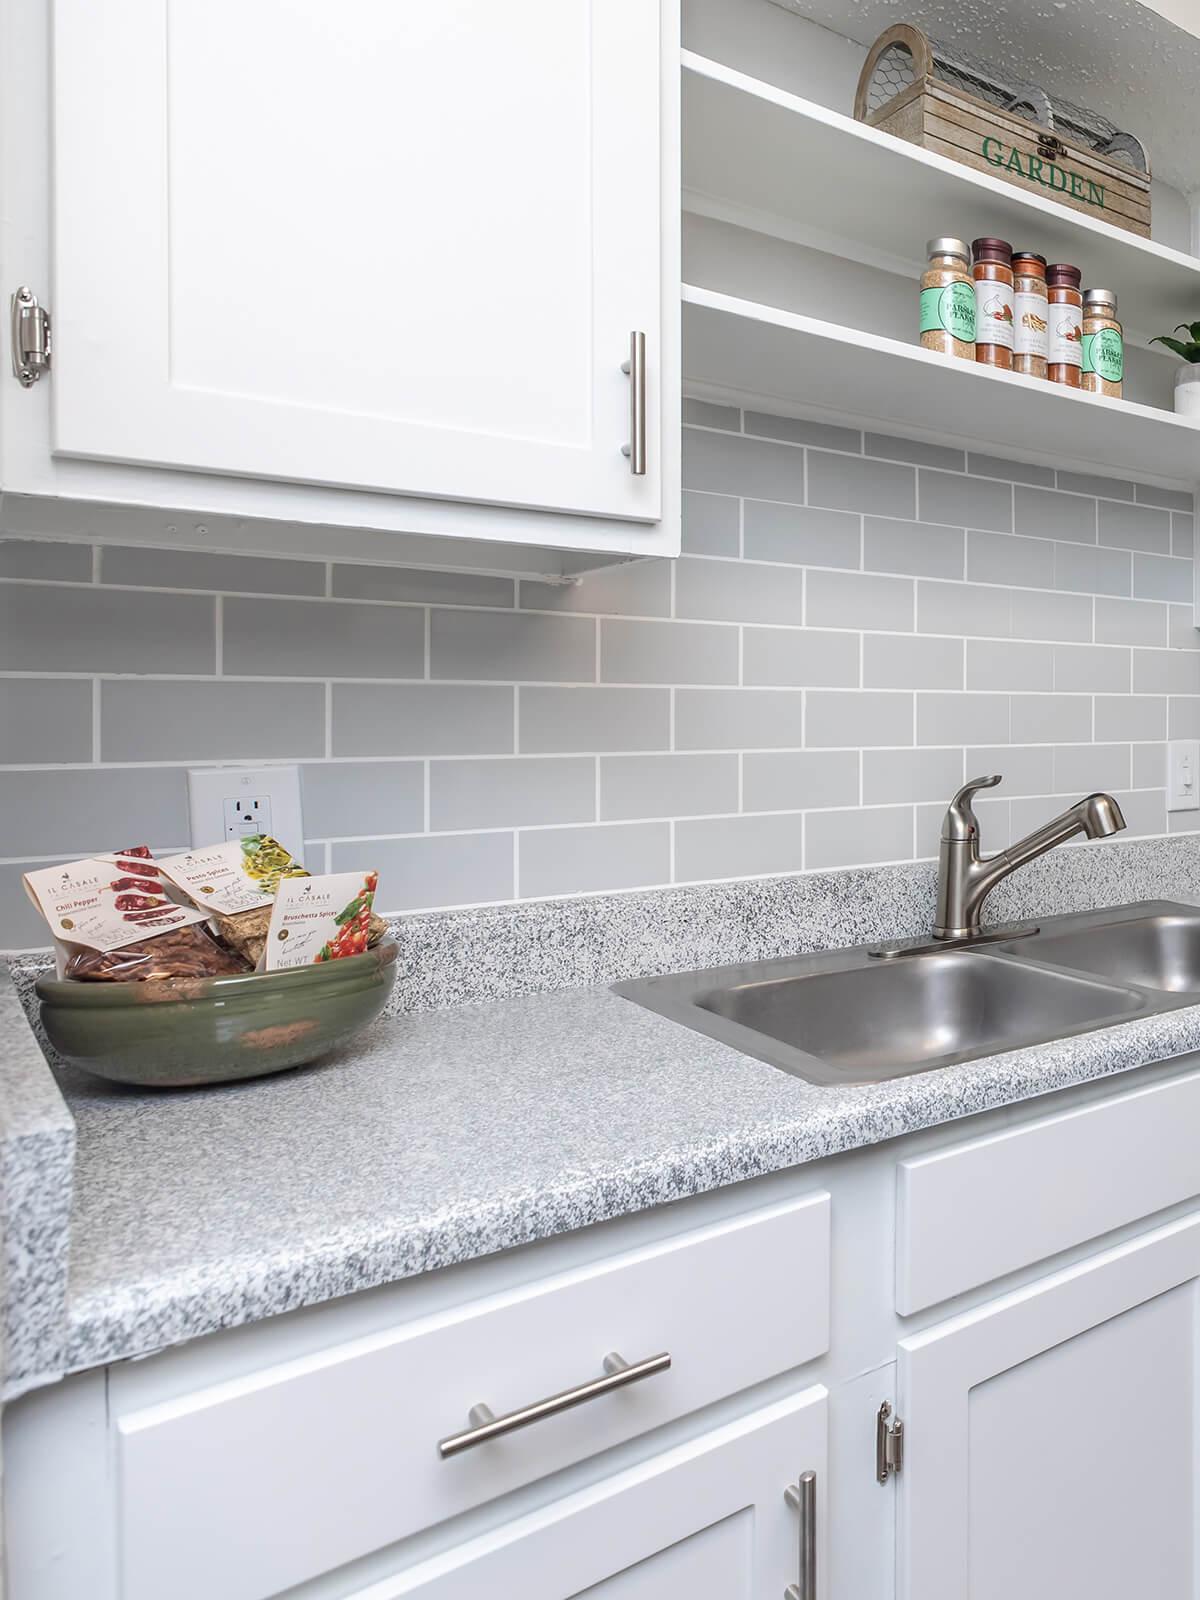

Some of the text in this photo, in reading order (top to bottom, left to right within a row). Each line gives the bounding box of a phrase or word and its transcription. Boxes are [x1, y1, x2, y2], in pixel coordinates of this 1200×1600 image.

[982, 135, 1106, 208] GARDEN
[73, 897, 98, 908] Pepper
[283, 911, 337, 921] Bruschetta Spices
[276, 958, 292, 968] Net
